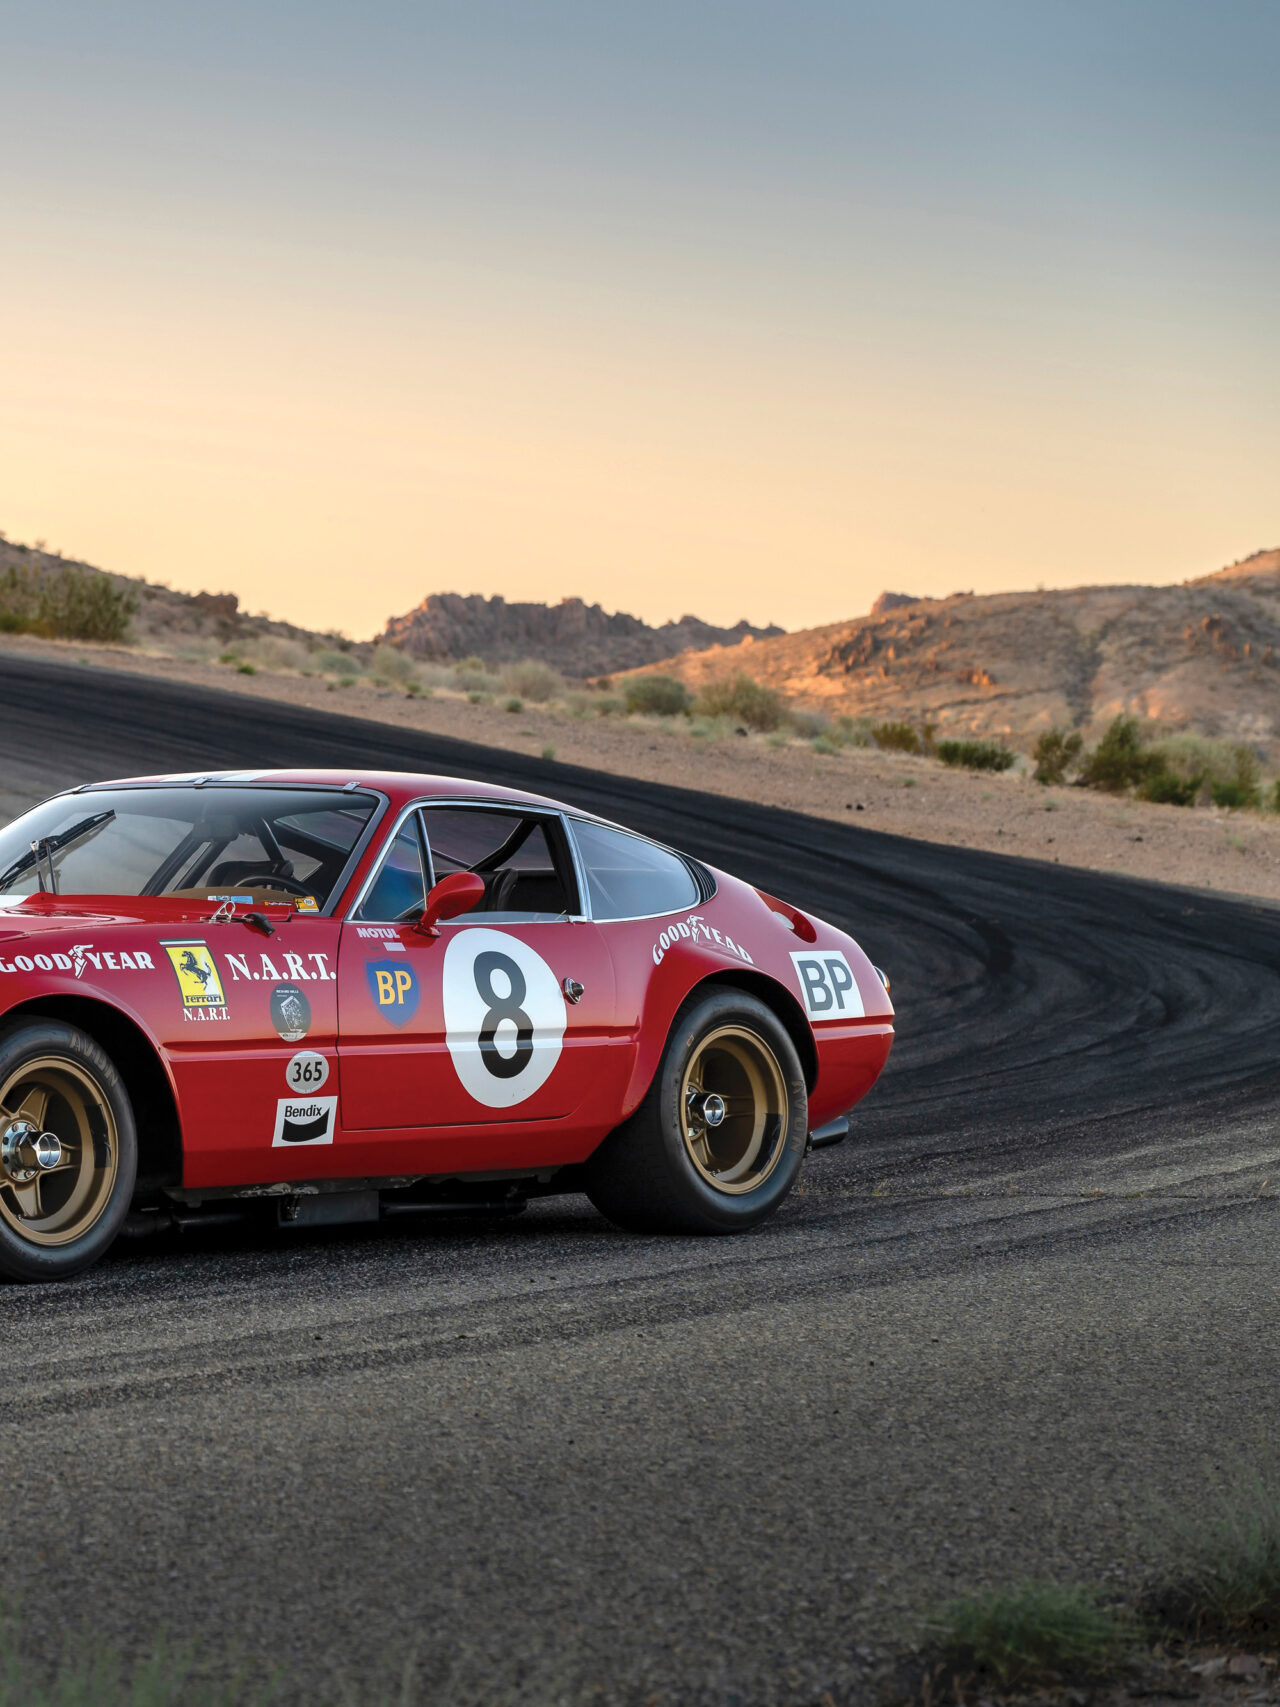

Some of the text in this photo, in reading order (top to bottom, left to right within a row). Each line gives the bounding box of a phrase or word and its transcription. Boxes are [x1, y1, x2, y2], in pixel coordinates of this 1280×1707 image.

[356, 928, 401, 938] MOTUL
[224, 953, 337, 981] N.A.R.T.
[376, 970, 412, 1005] BP
[797, 958, 853, 1012] BP
[185, 994, 223, 1003] Ferrari
[183, 1007, 231, 1021] N.A.R.T.
[473, 951, 533, 1079] 8
[69, 1031, 119, 1087] AVON
[292, 1061, 323, 1083] 365
[284, 1104, 323, 1118] Bendix
